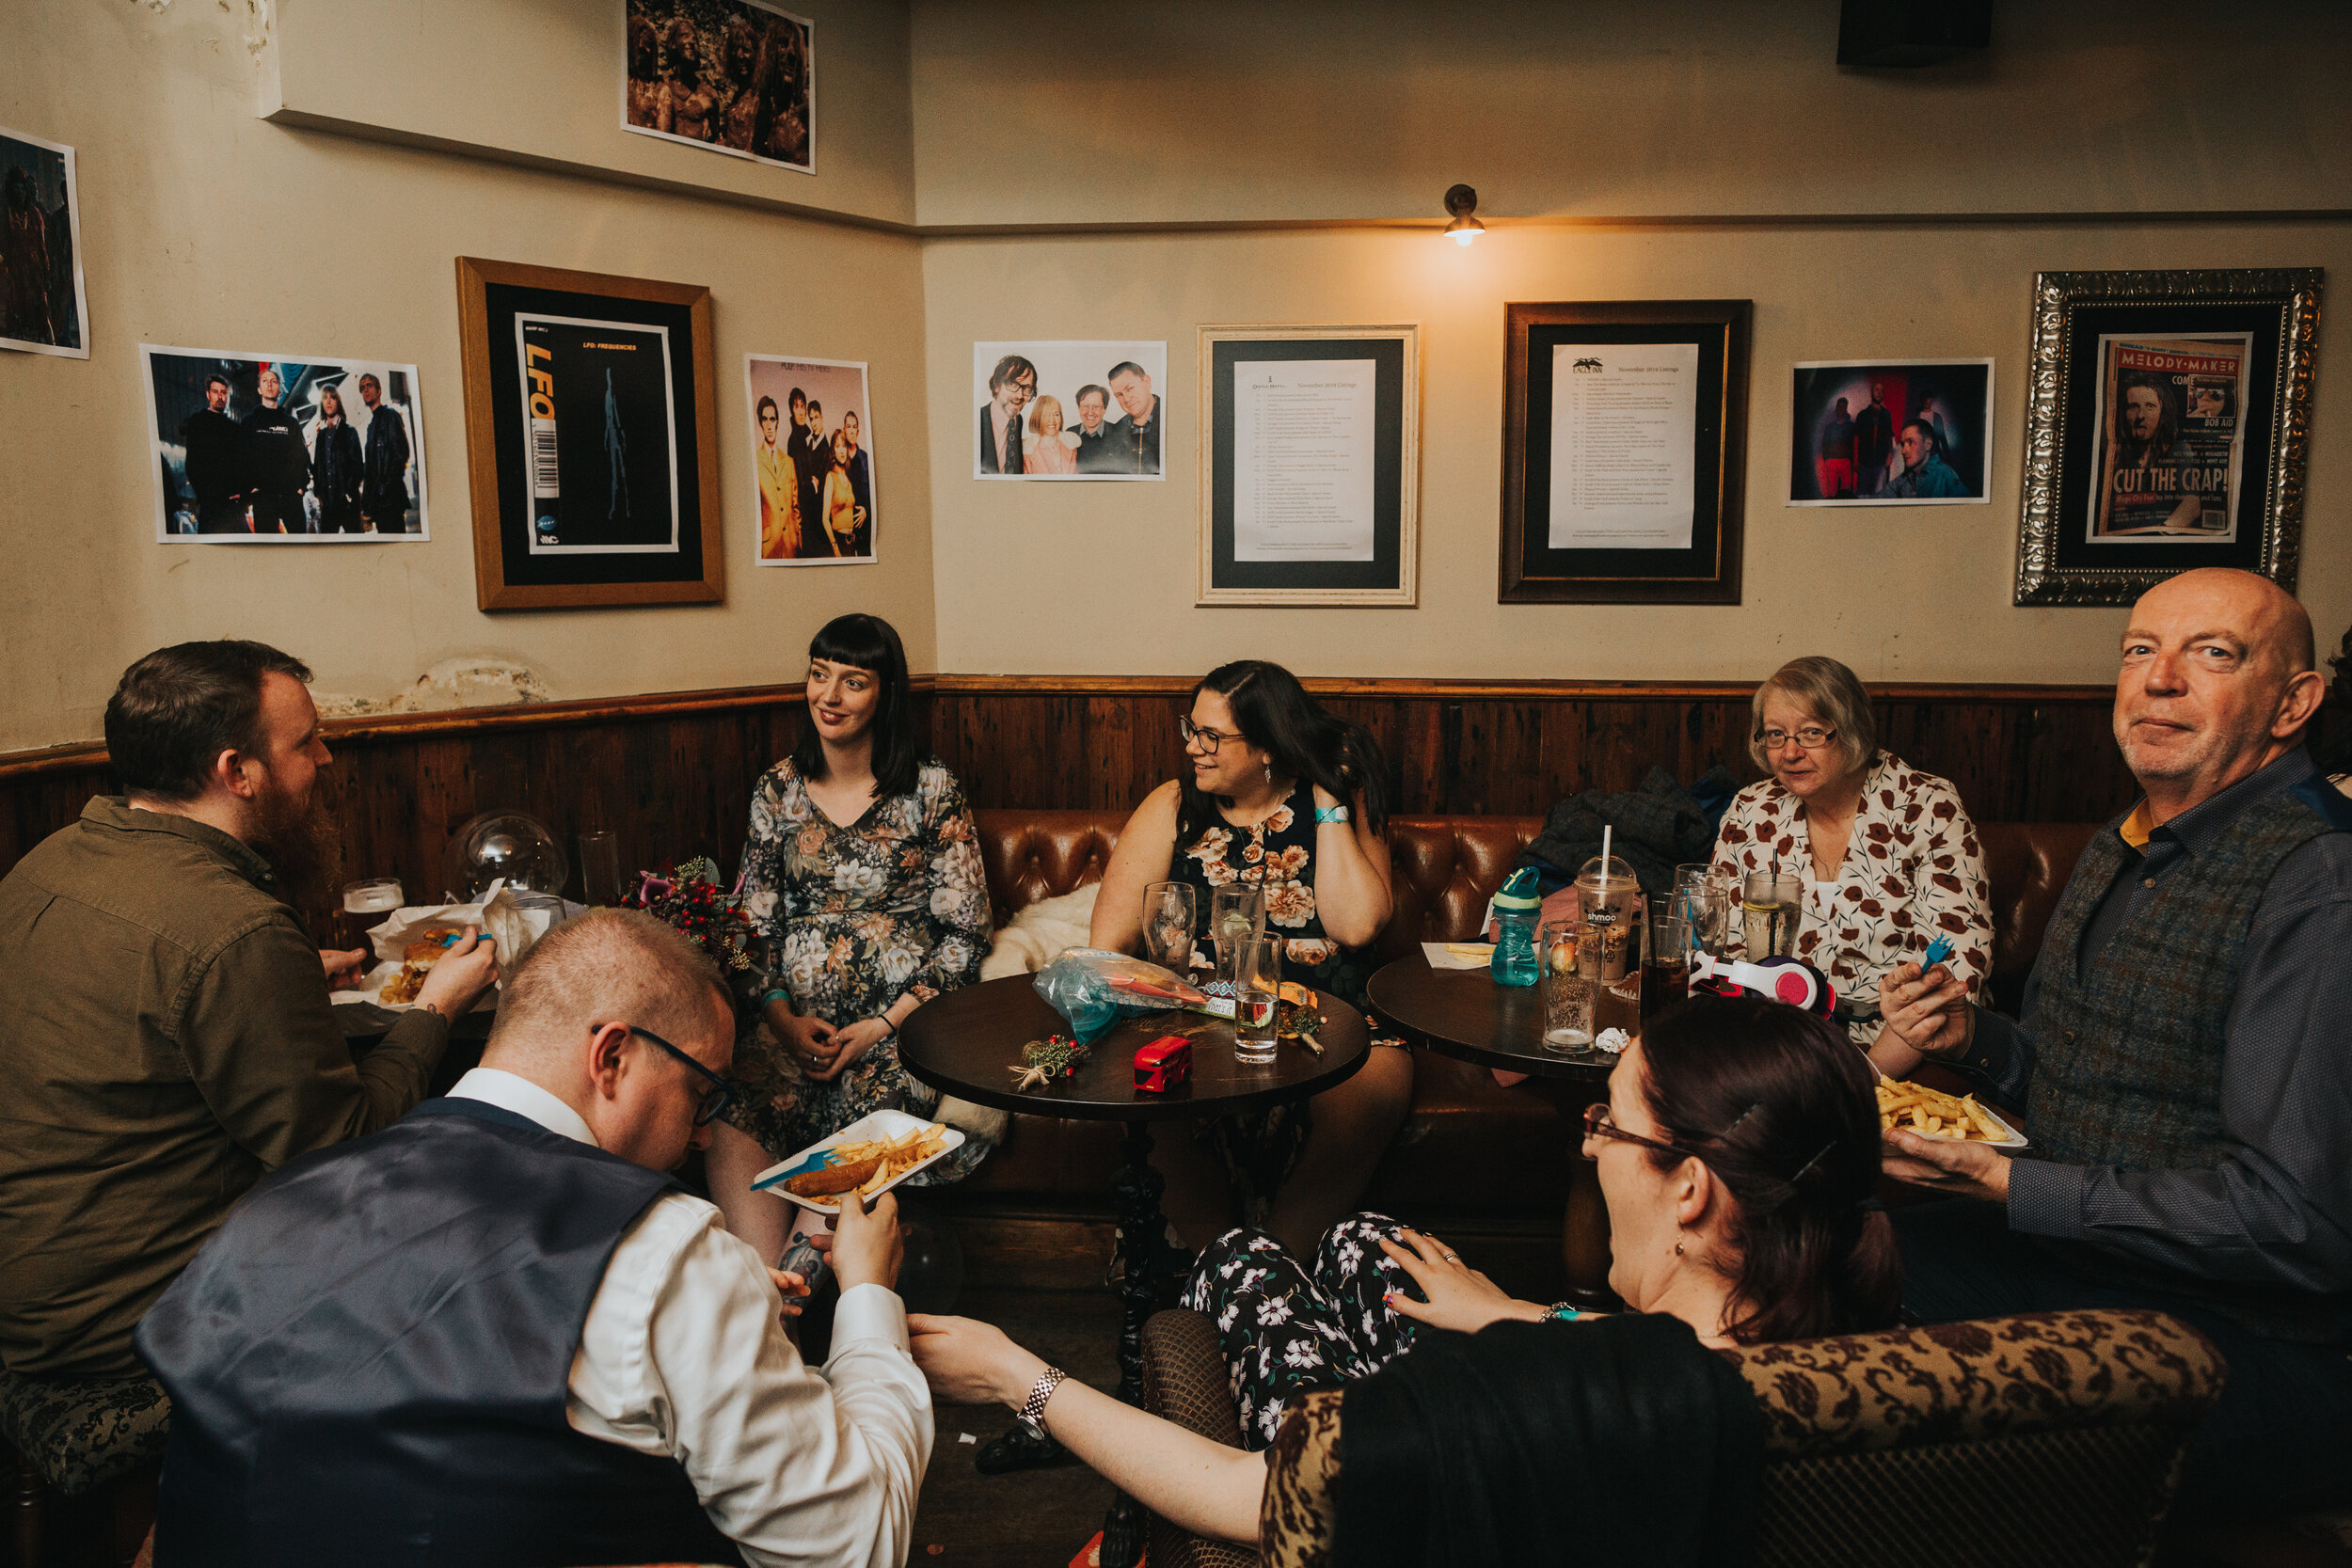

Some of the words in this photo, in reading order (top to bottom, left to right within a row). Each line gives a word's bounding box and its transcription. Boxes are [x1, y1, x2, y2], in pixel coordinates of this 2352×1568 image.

[597, 342, 637, 351] FREQUENCIES
[2188, 360, 2235, 372] MAKER
[526, 343, 555, 420] LFO
[2171, 375, 2195, 386] COME
[2204, 419, 2219, 427] BOB
[2220, 419, 2233, 427] AID
[2113, 468, 2145, 494] CUT
[2150, 467, 2177, 492] THE
[2182, 467, 2228, 492] CRAP!
[1587, 912, 1616, 921] shmoo
